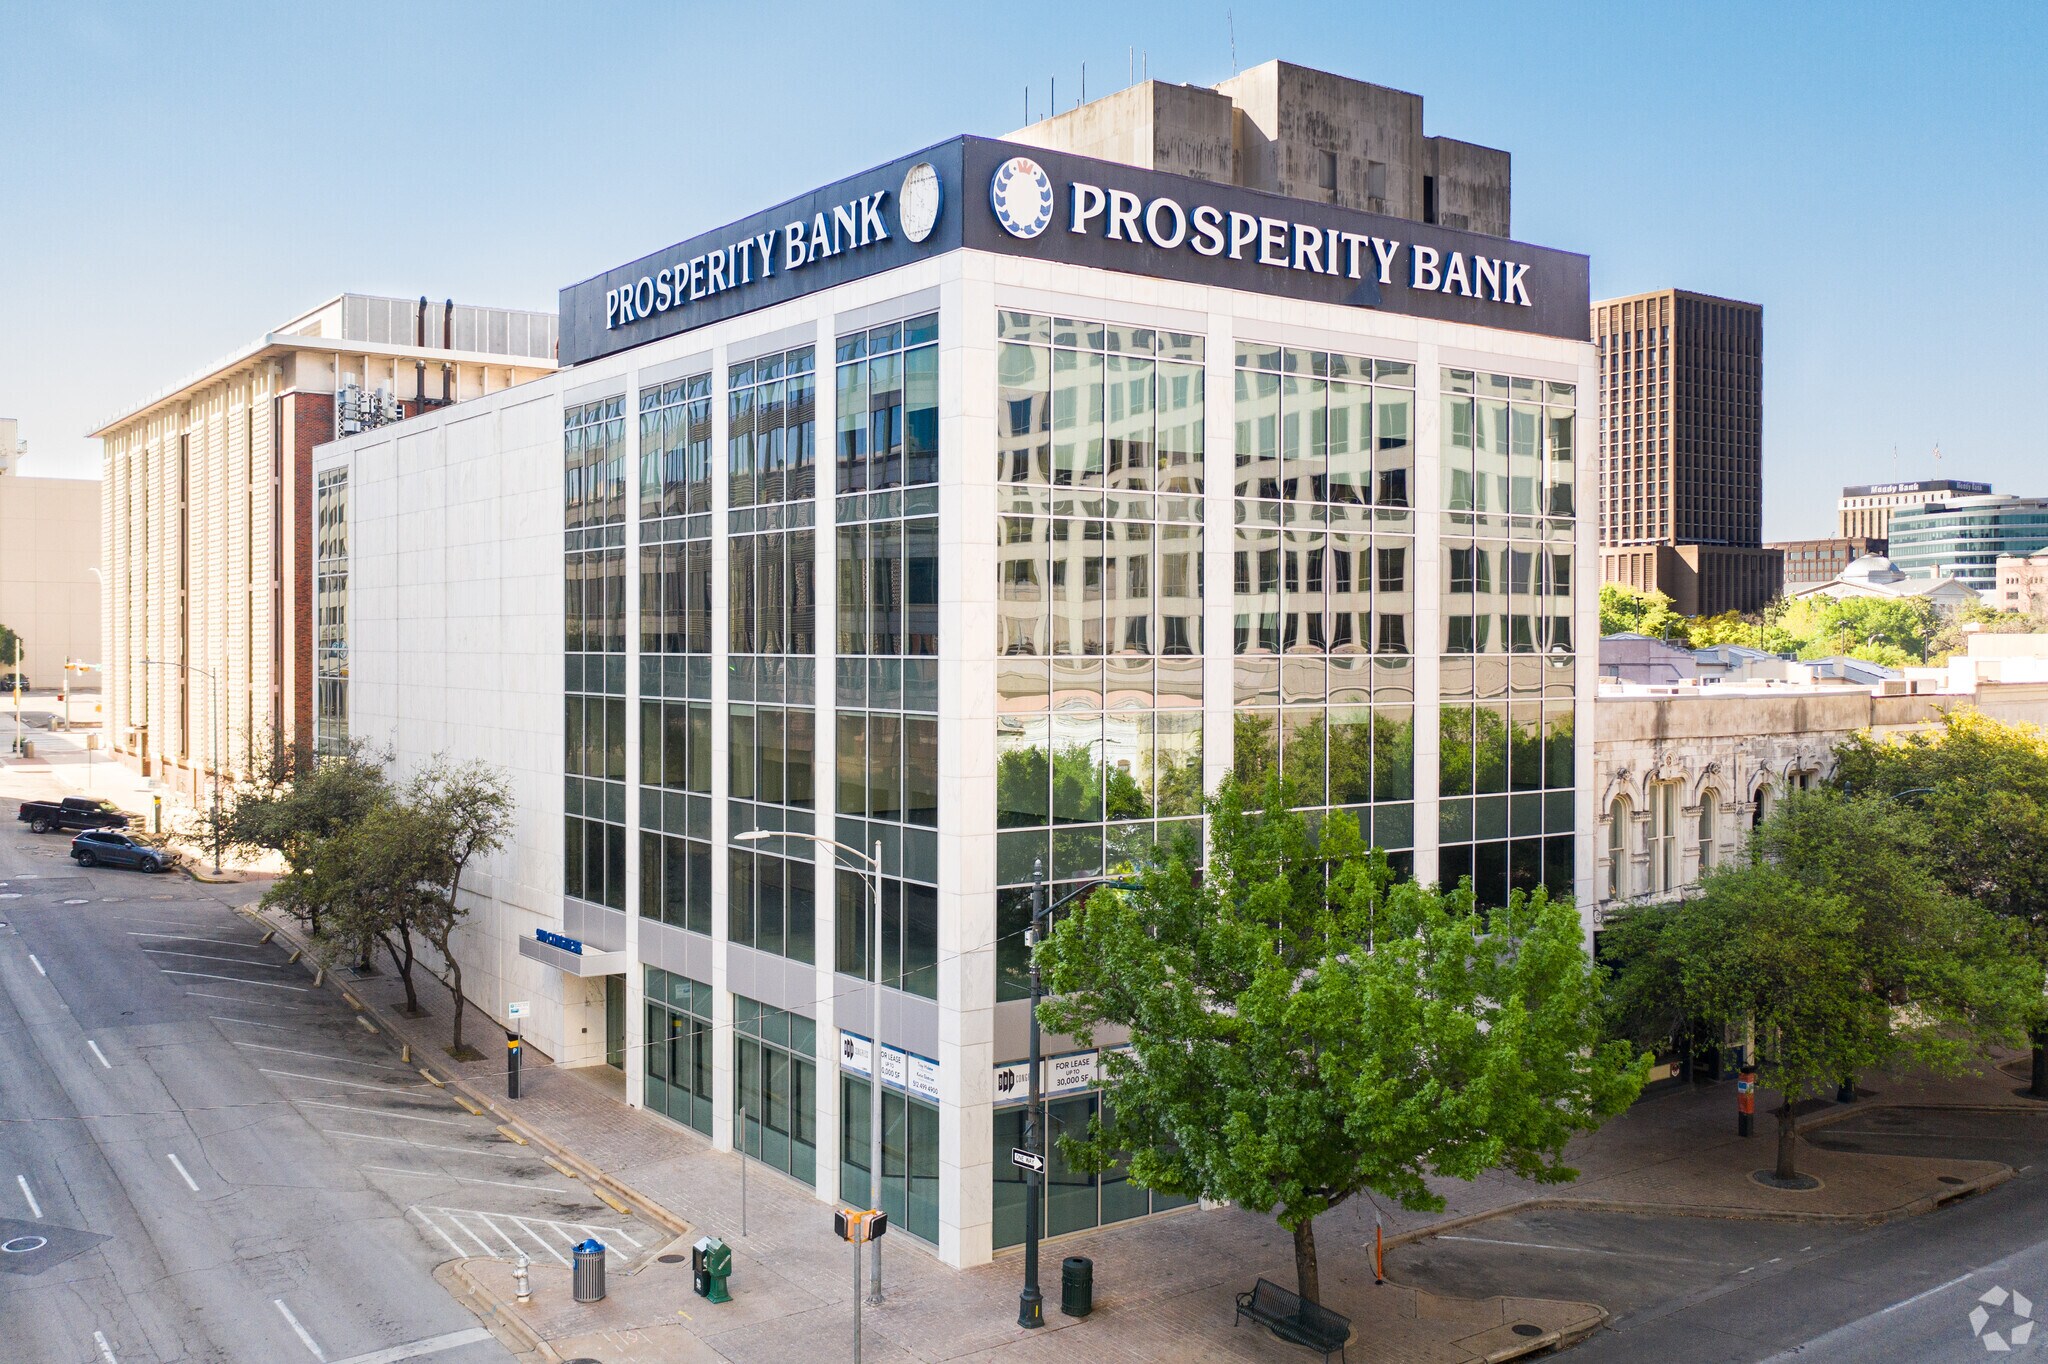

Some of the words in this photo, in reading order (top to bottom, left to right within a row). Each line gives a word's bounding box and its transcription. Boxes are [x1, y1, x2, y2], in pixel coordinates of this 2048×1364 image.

[1071, 183, 1400, 285] PROSPERITY
[1412, 245, 1532, 307] BANK
[606, 229, 777, 329] PROSPERITY
[785, 190, 888, 270] BANK
[1870, 485, 1897, 493] Moody
[1898, 482, 1919, 491] Bank
[888, 1054, 901, 1063] LEASE
[1055, 1061, 1070, 1070] FOR
[1070, 1058, 1090, 1068] LEASE
[880, 1067, 894, 1077] 0,000
[1056, 1076, 1080, 1087] 30,000
[1080, 1073, 1089, 1082] SF
